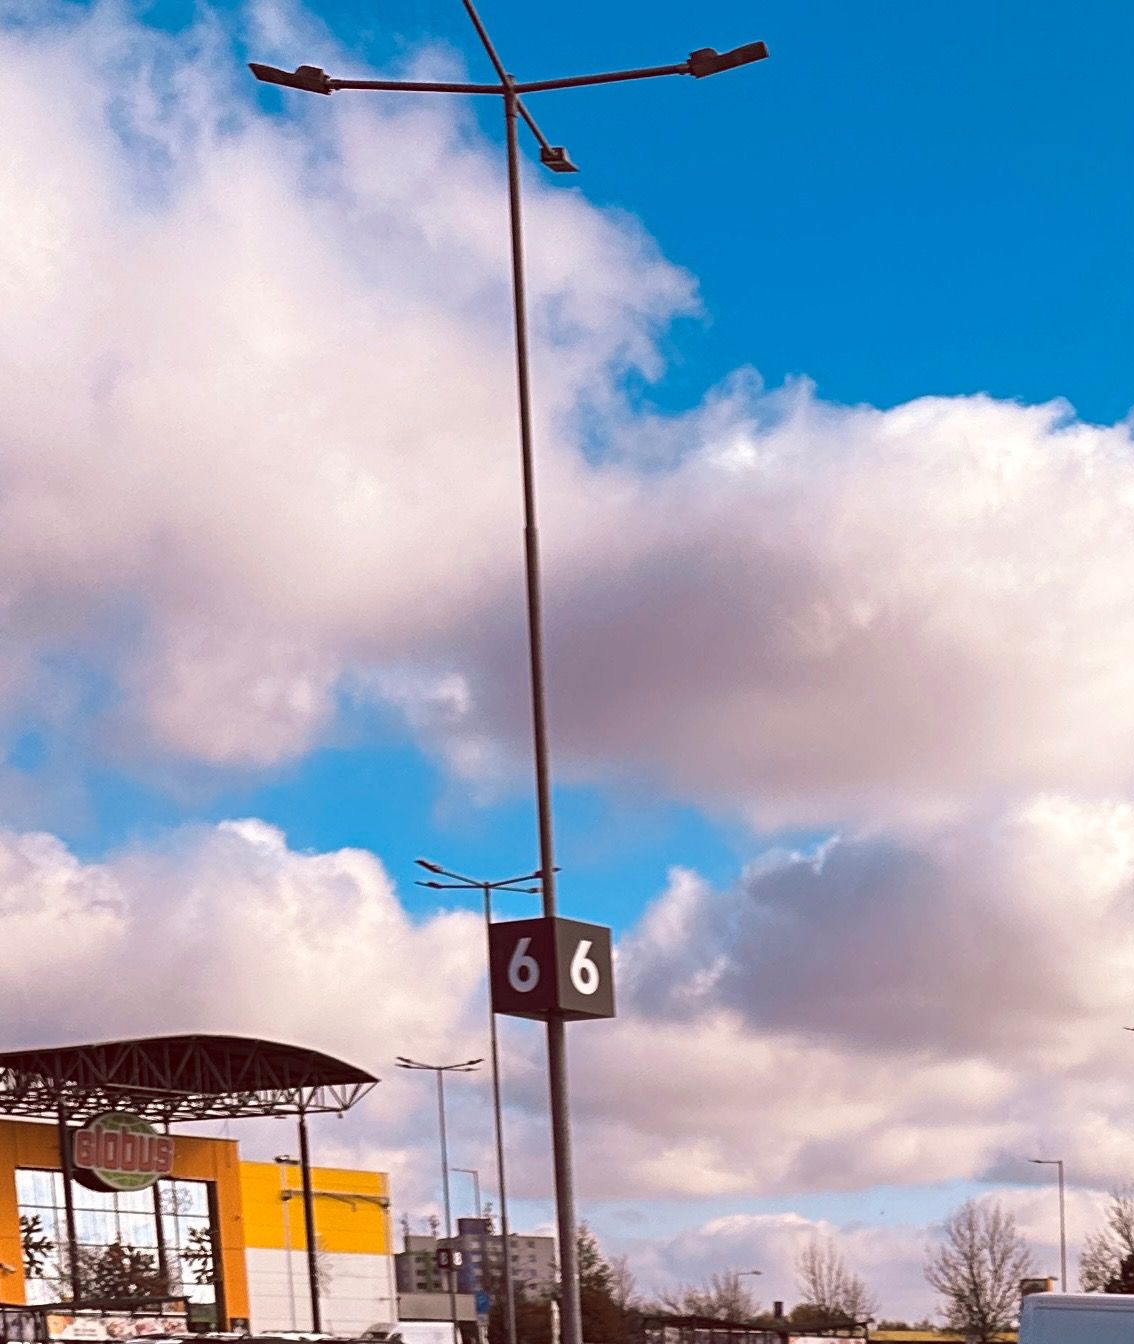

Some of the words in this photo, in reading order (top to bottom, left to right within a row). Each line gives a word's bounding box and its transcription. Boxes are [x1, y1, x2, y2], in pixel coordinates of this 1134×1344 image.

[509, 937, 540, 993] 6
[570, 940, 600, 995] 6
[76, 1123, 174, 1173] Globus
